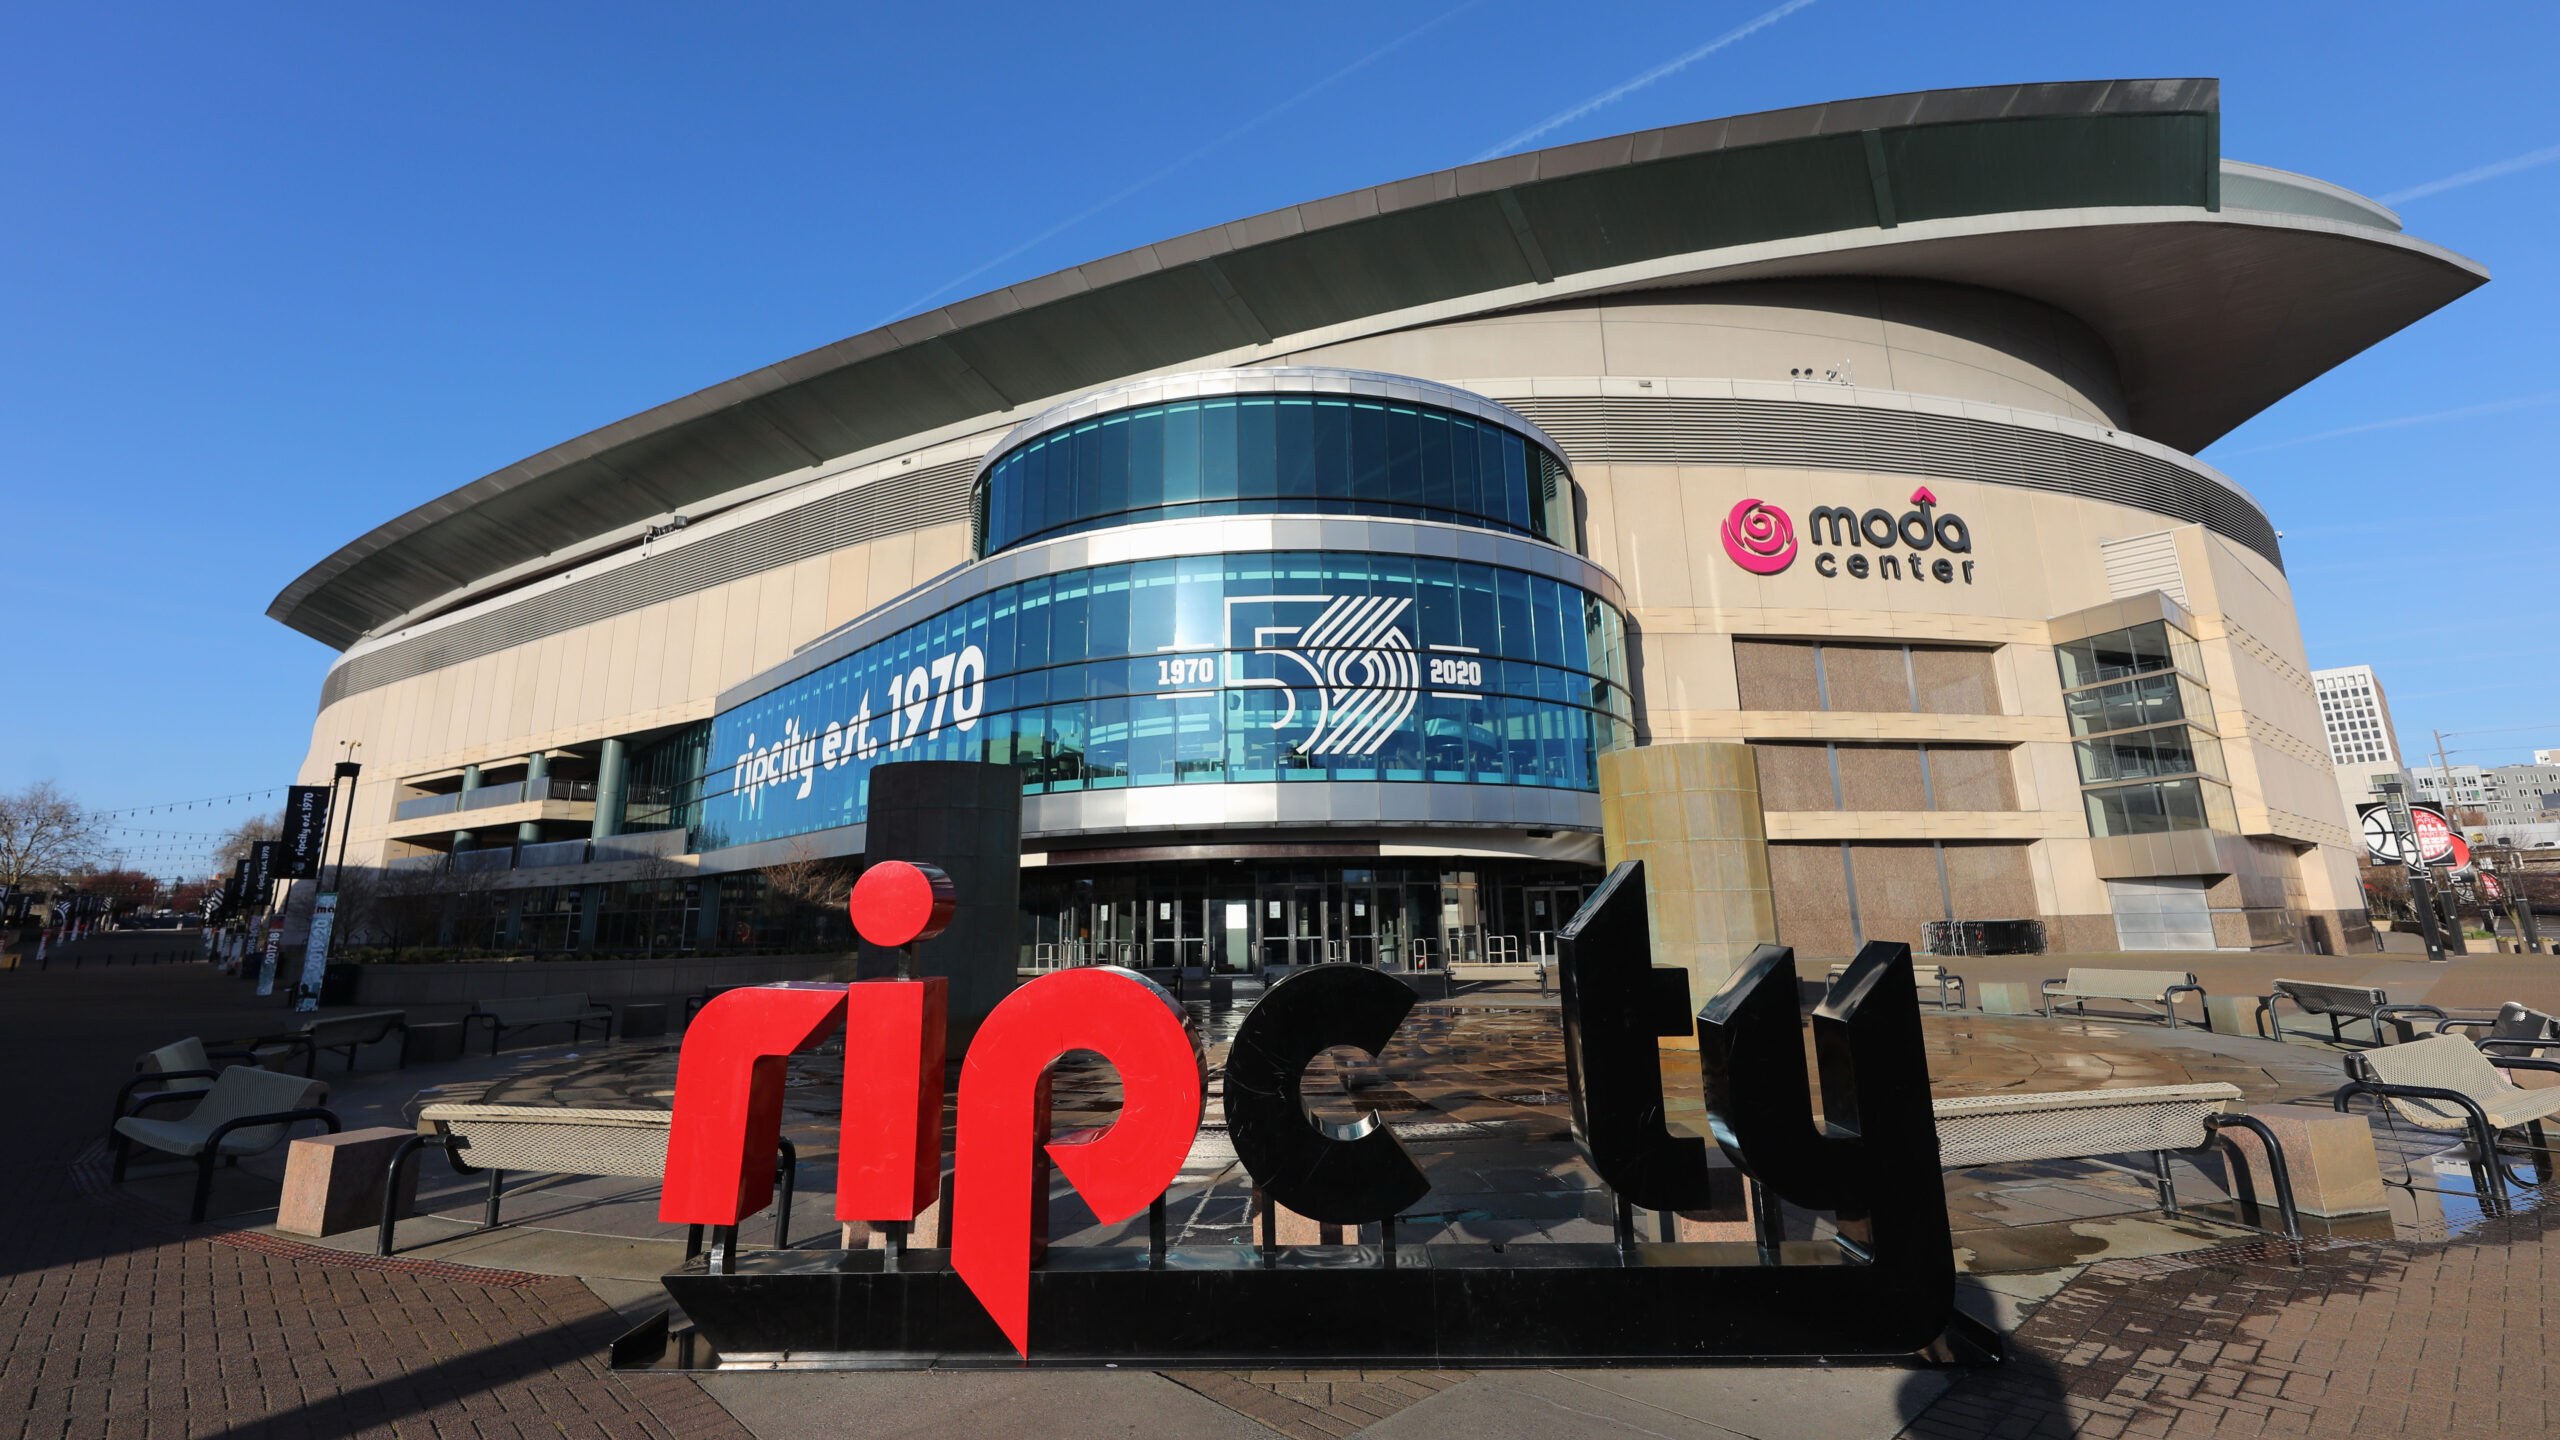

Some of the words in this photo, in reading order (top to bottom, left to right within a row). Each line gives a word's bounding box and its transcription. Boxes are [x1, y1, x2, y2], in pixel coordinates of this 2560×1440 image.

[1809, 486, 1971, 554] moda
[1815, 552, 1975, 585] center
[1157, 658, 1214, 686] 1970
[1430, 658, 1482, 686] 2020
[733, 714, 817, 812] ripcity
[822, 687, 878, 771] est.
[887, 644, 985, 752] 1970
[302, 792, 314, 811] 1970
[294, 829, 312, 856] ripcity
[264, 932, 280, 965] 2017-18
